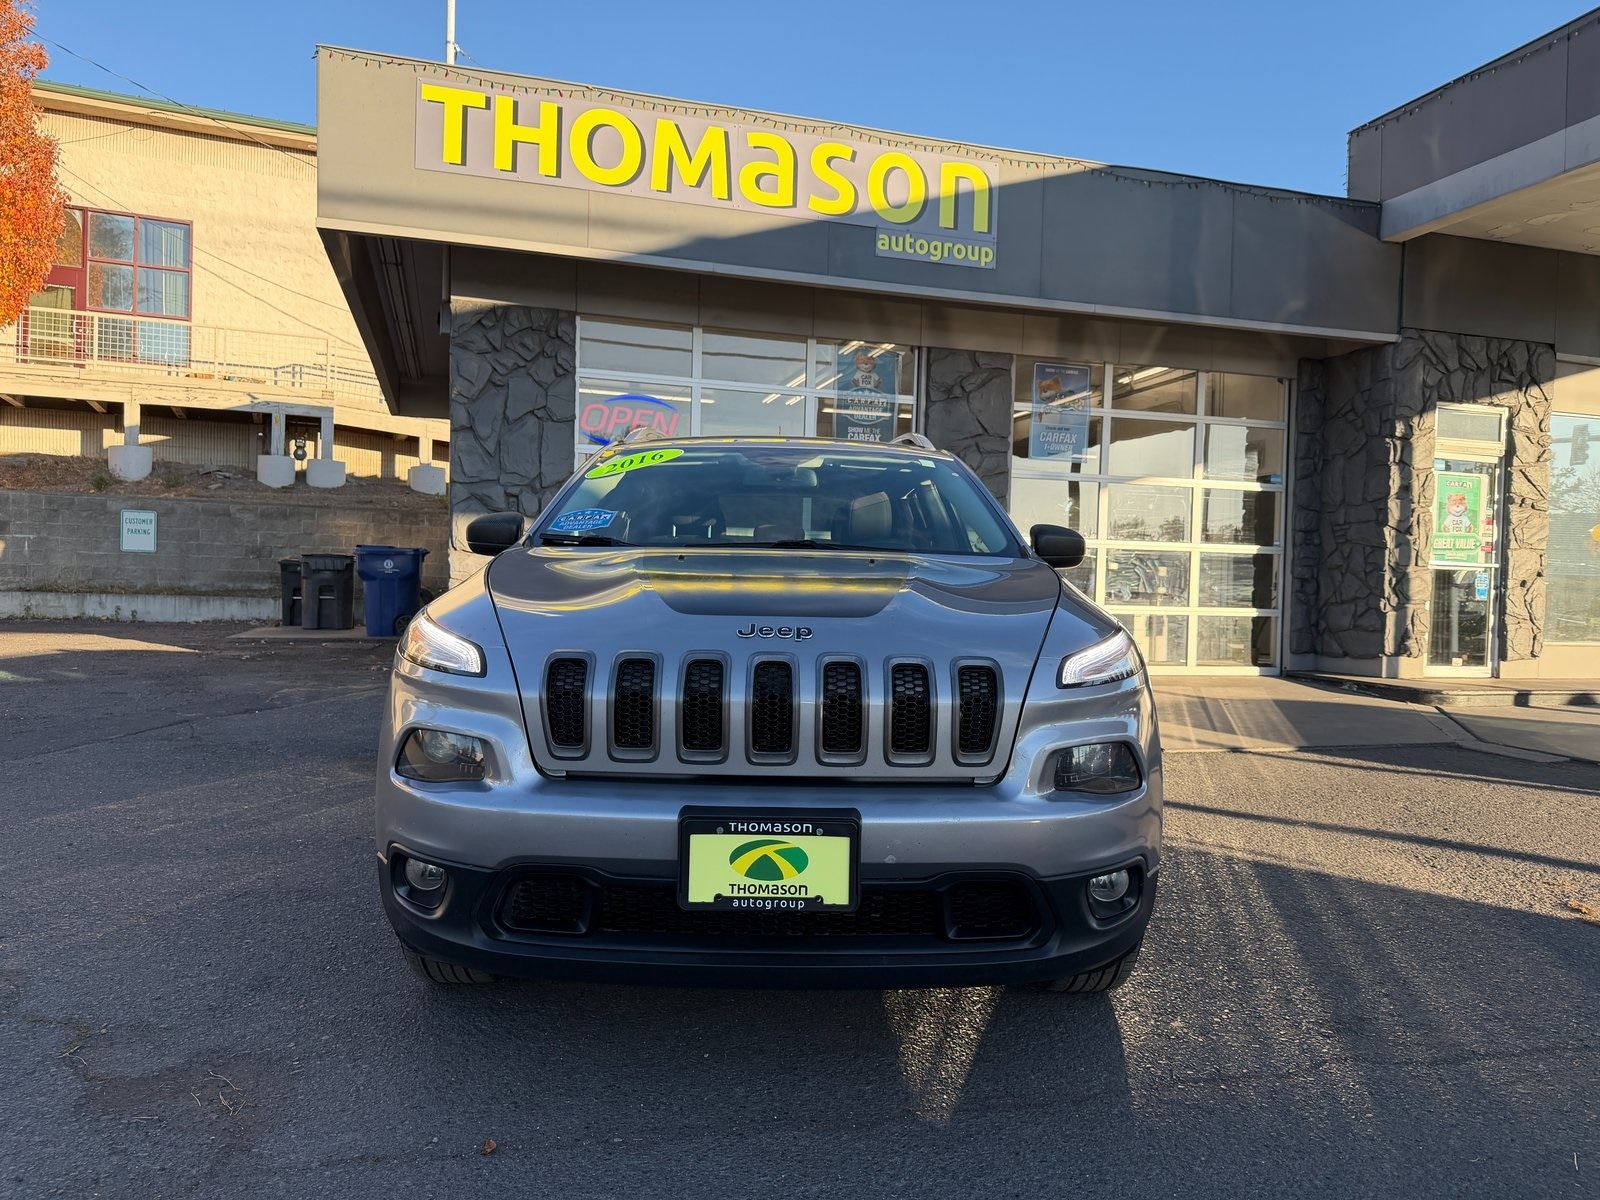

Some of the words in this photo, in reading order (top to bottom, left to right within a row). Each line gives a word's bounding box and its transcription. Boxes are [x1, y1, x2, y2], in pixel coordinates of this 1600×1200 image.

[877, 233, 995, 267] autogroup
[580, 403, 680, 438] OPEN
[848, 433, 880, 442] CARFAX
[1040, 431, 1077, 443] CARFAX
[604, 452, 664, 474] 2016
[125, 517, 153, 525] CUSTOMER
[127, 527, 151, 535] PARKING
[1433, 538, 1455, 549] GREAT
[1455, 538, 1477, 550] VALUE
[736, 623, 813, 641] Jeep
[732, 898, 805, 910] autogroup
